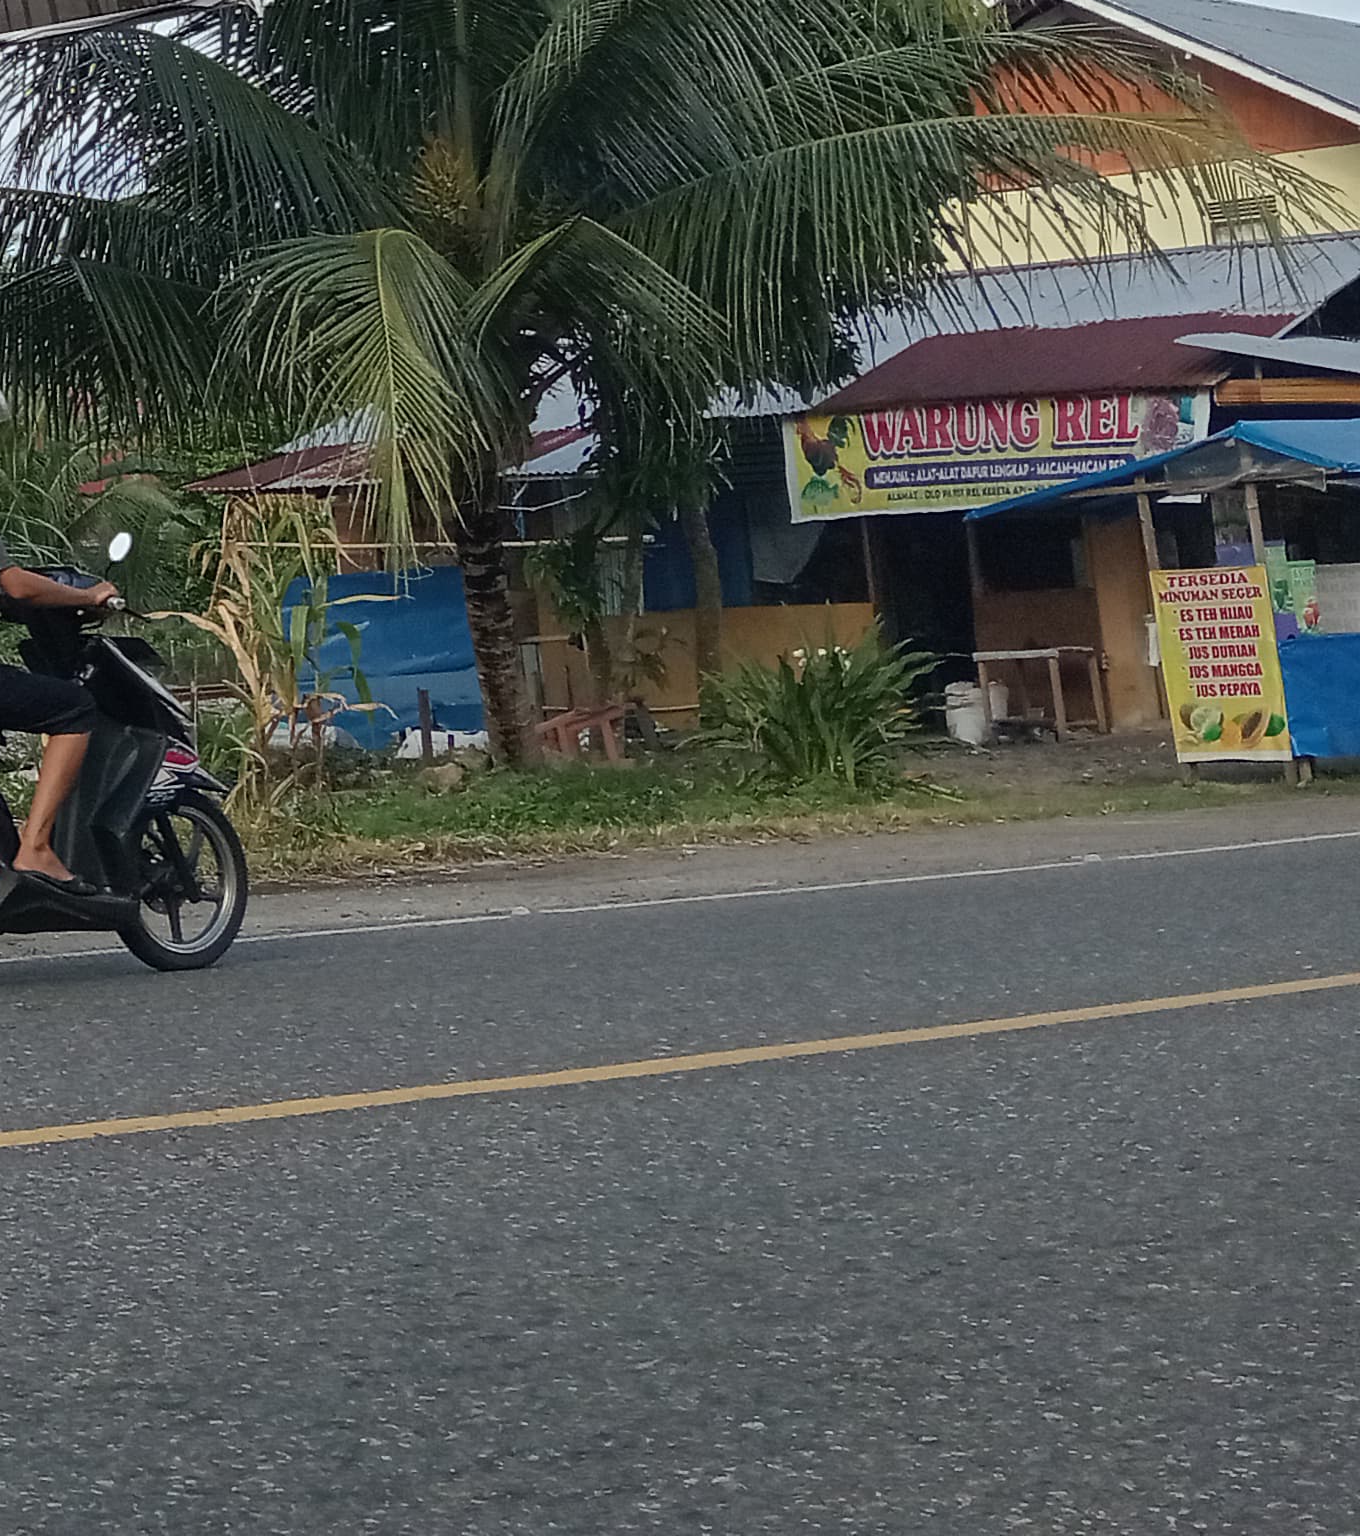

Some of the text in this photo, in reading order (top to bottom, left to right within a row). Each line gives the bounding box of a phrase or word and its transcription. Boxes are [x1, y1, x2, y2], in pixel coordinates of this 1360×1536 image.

[862, 395, 1139, 457] WARUNG REL
[873, 470, 910, 485] MENJUAL
[915, 467, 960, 483] ALAT-ALAT
[961, 465, 989, 480] DAPUR
[990, 463, 1029, 479] LENGKAP
[1036, 459, 1107, 476] MACAM-MACAM
[1167, 572, 1248, 588] TERSEDIA
[1159, 586, 1262, 603] MINUMAN SEGER
[1181, 606, 1253, 622] ES TEH HIJAU
[1180, 625, 1260, 641] ES TEH MERAH
[1189, 644, 1256, 660] JUS DURIAN
[1189, 663, 1263, 679] JUS MANGGA
[1196, 682, 1261, 697] JUS PEPAYA
